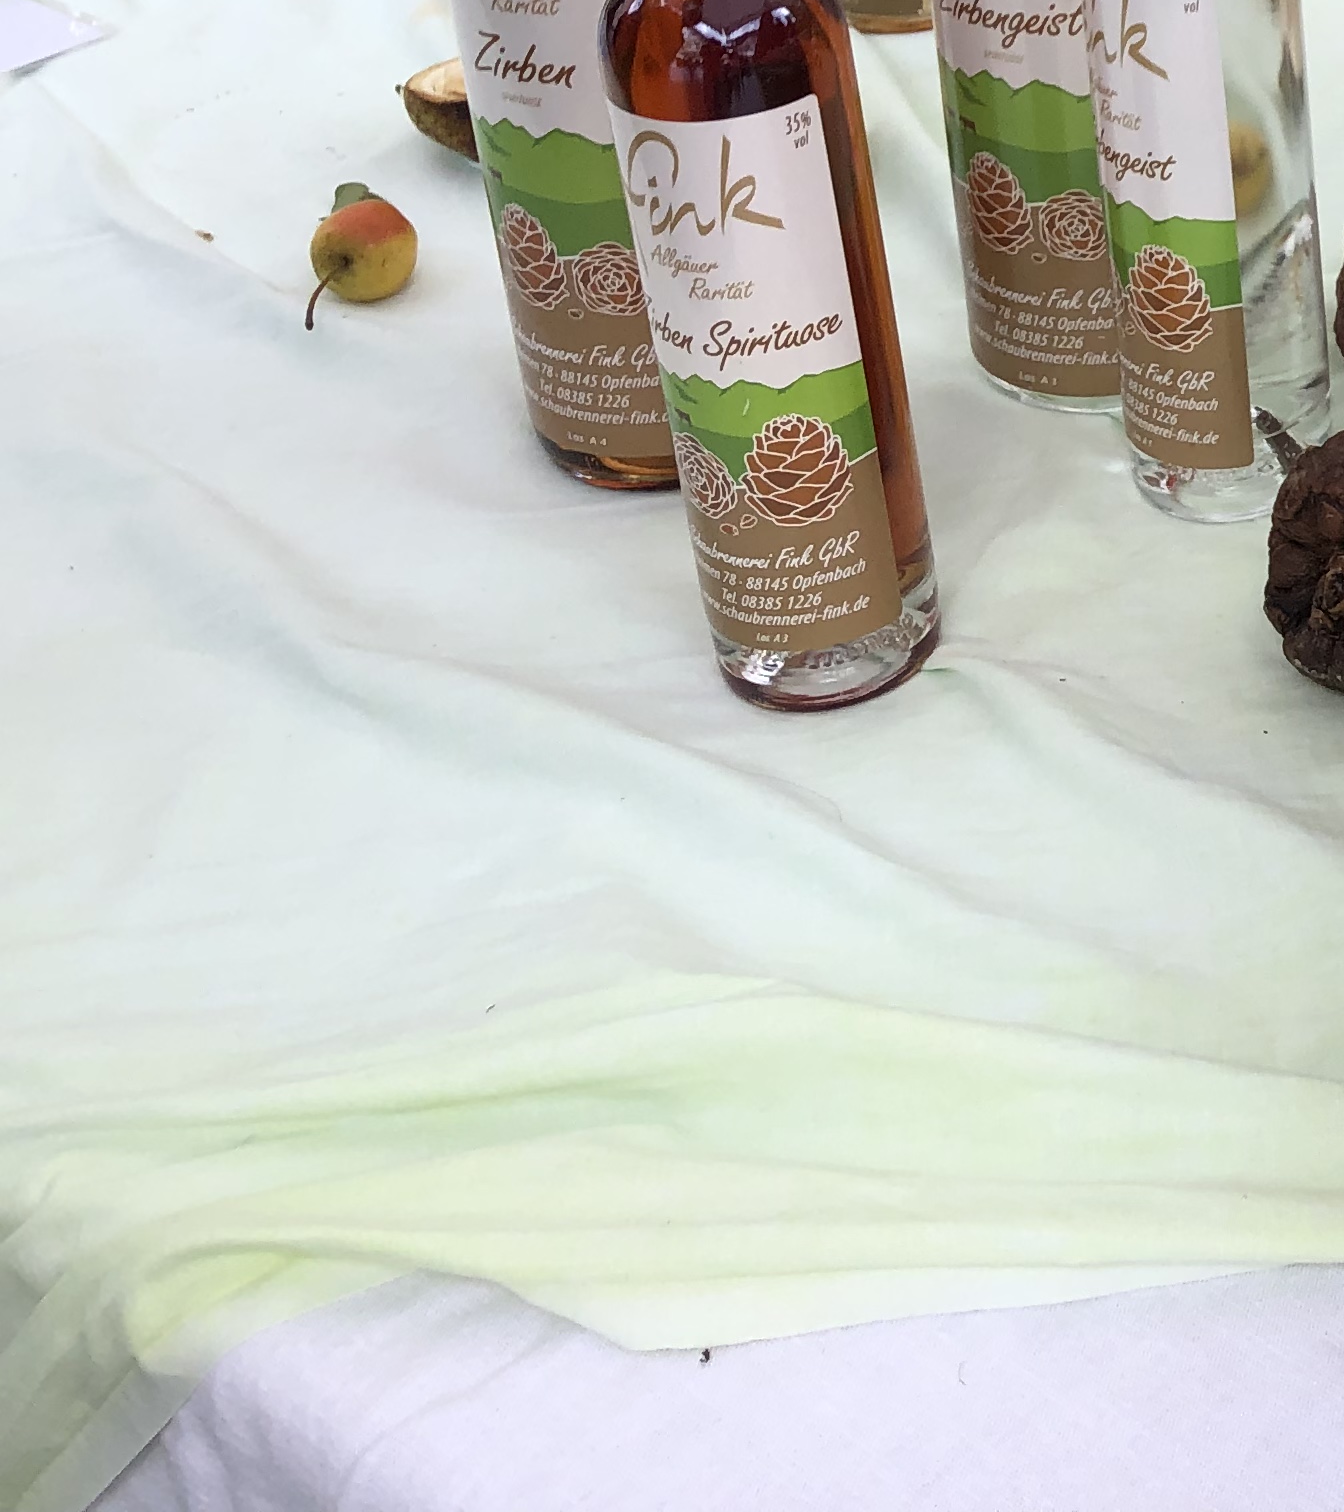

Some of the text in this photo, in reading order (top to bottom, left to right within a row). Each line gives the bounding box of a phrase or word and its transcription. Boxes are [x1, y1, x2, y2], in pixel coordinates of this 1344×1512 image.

[1183, 0, 1200, 13] vol
[473, 30, 576, 89] Zirben
[784, 112, 812, 134] 35%
[793, 132, 811, 149] vol
[627, 129, 785, 236] fink
[650, 244, 718, 279] Allgäuer
[689, 277, 754, 300] Rarität
[1047, 287, 1113, 314] Fink Gb
[1017, 312, 1056, 329] 88145
[1057, 317, 1116, 333] Opfenba
[702, 311, 844, 371] Spirituose
[1012, 328, 1049, 347] 08385
[1052, 336, 1084, 349] 1226
[588, 343, 657, 373] Fink Gb
[541, 362, 660, 392] 78 88145 Opfenba
[1145, 363, 1215, 394] Fink GbR
[540, 378, 631, 408] Tel. 08385 1226
[1156, 391, 1219, 411] Opfenbach
[1152, 408, 1179, 426] 1226
[775, 530, 860, 570] Fink GbR
[723, 558, 866, 592] 78 88145 Opfenbach
[721, 587, 823, 611] Tel. 08385 1226
